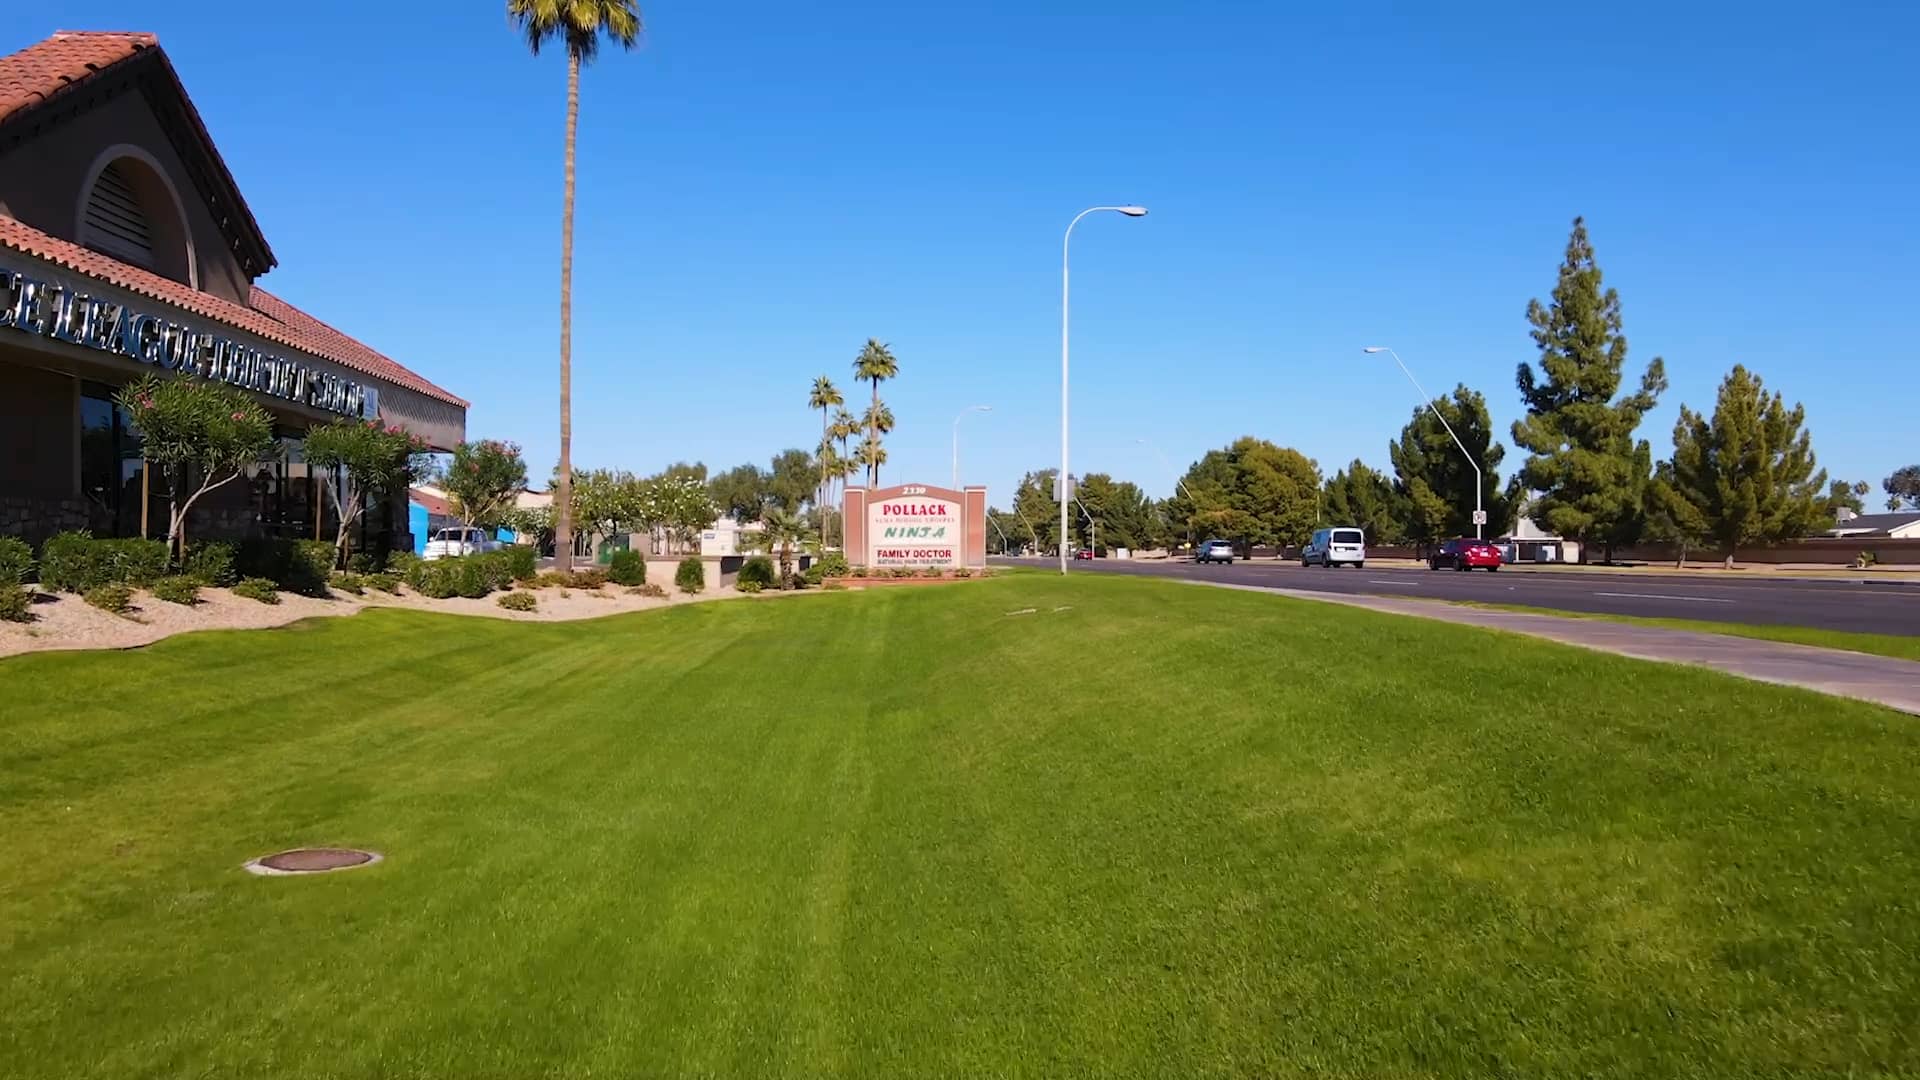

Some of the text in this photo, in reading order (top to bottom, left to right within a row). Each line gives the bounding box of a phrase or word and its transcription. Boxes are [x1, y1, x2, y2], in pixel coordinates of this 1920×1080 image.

[51, 284, 202, 374] LEAGUE
[883, 504, 947, 516] POLLACK
[884, 527, 946, 538] NINJA
[877, 550, 952, 558] FAMILY DOCTOR
